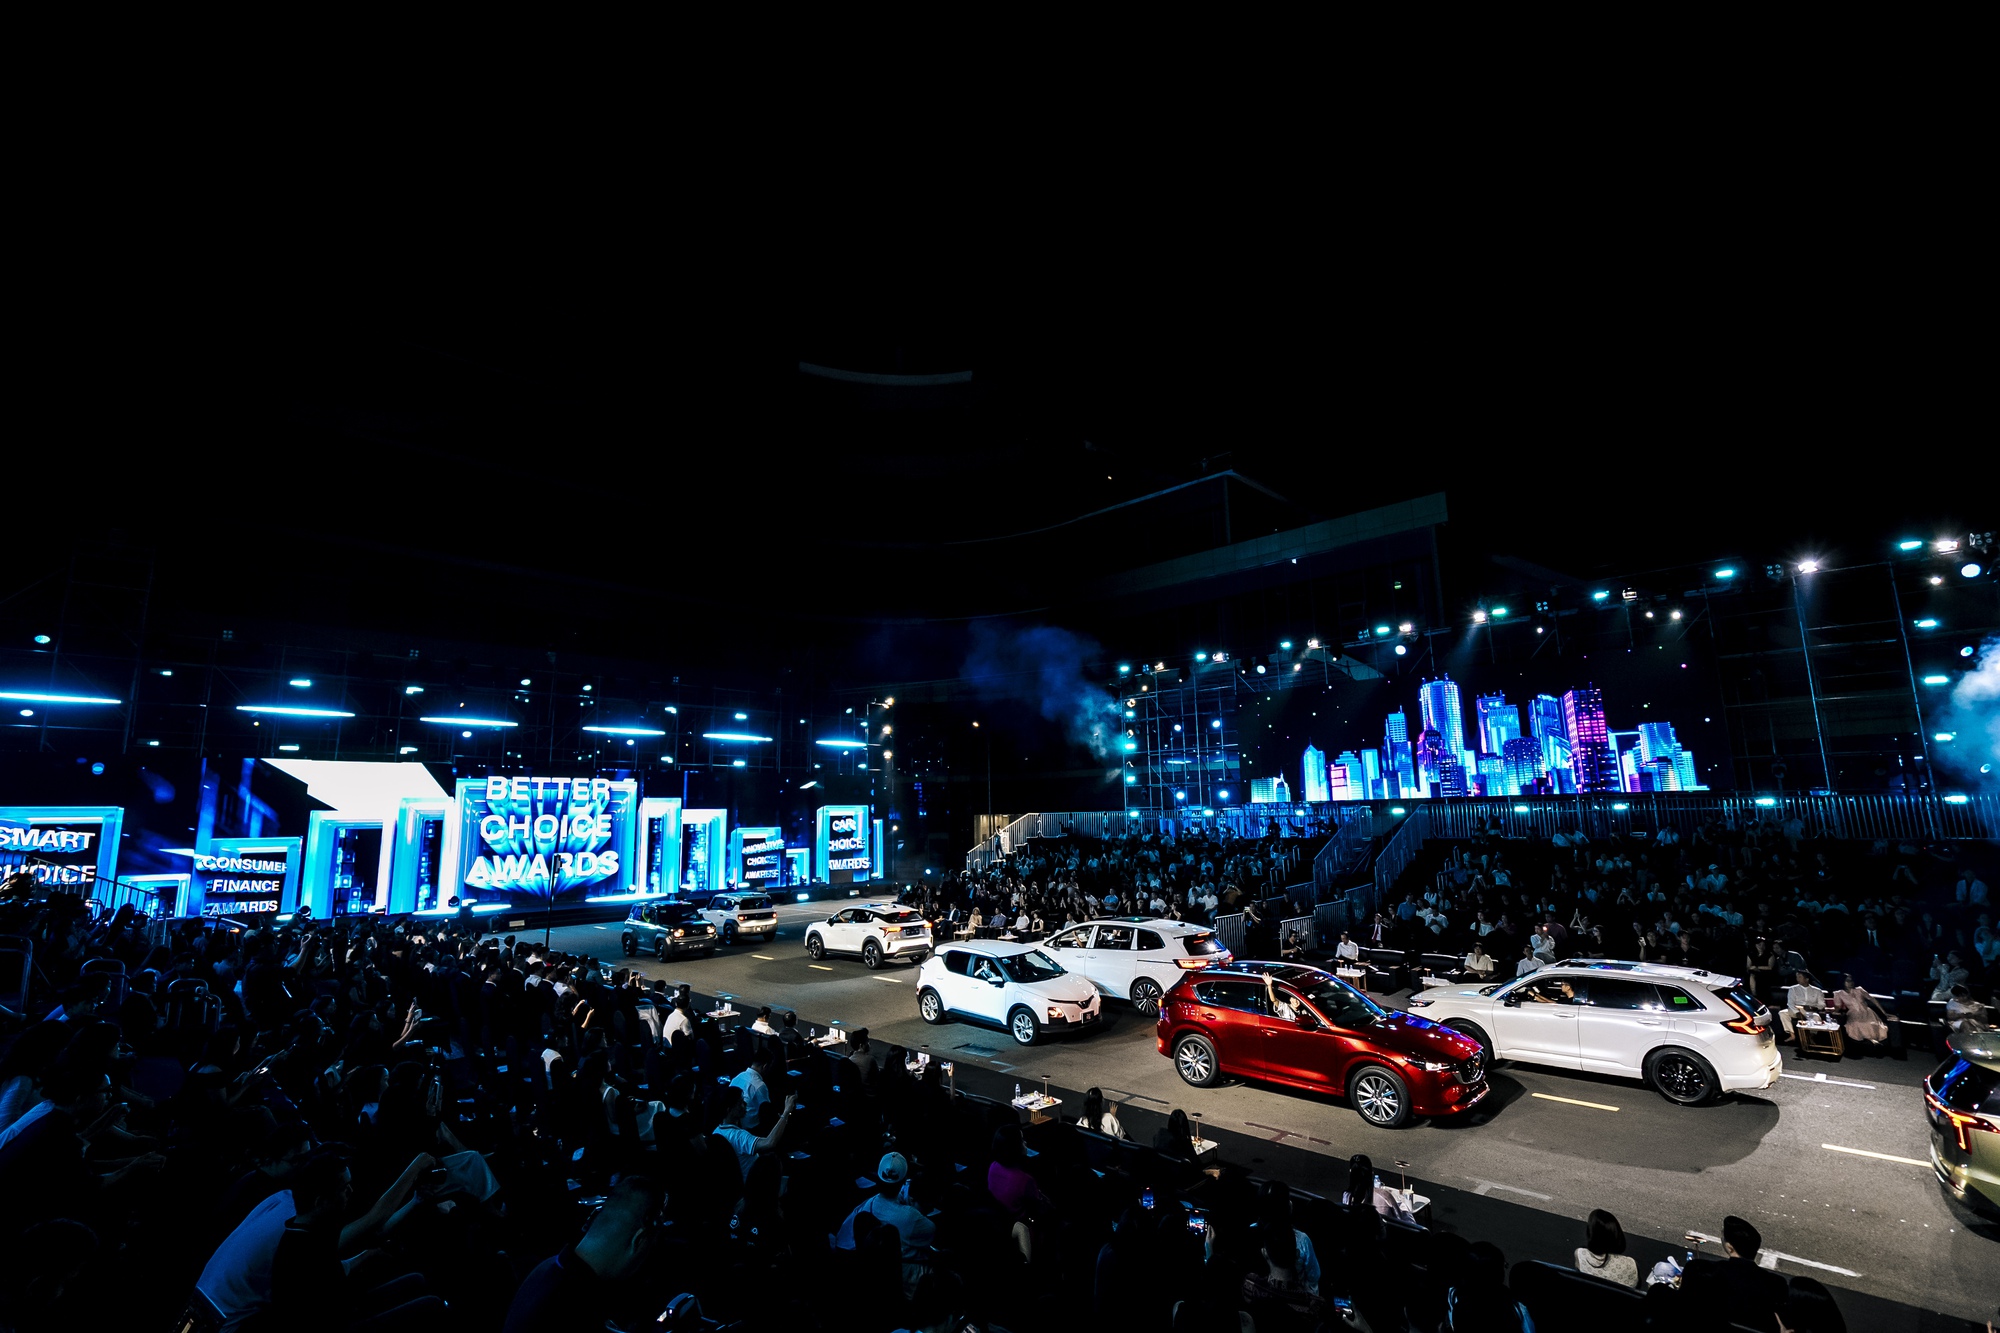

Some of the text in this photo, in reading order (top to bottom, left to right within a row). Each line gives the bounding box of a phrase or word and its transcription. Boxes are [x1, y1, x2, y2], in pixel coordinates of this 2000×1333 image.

[485, 776, 610, 801] BETTER
[480, 814, 612, 840] CHOICE
[832, 818, 857, 831] CAR
[0, 827, 95, 848] SMART
[212, 879, 280, 892] FINANCE
[209, 900, 278, 916] AWARDS
